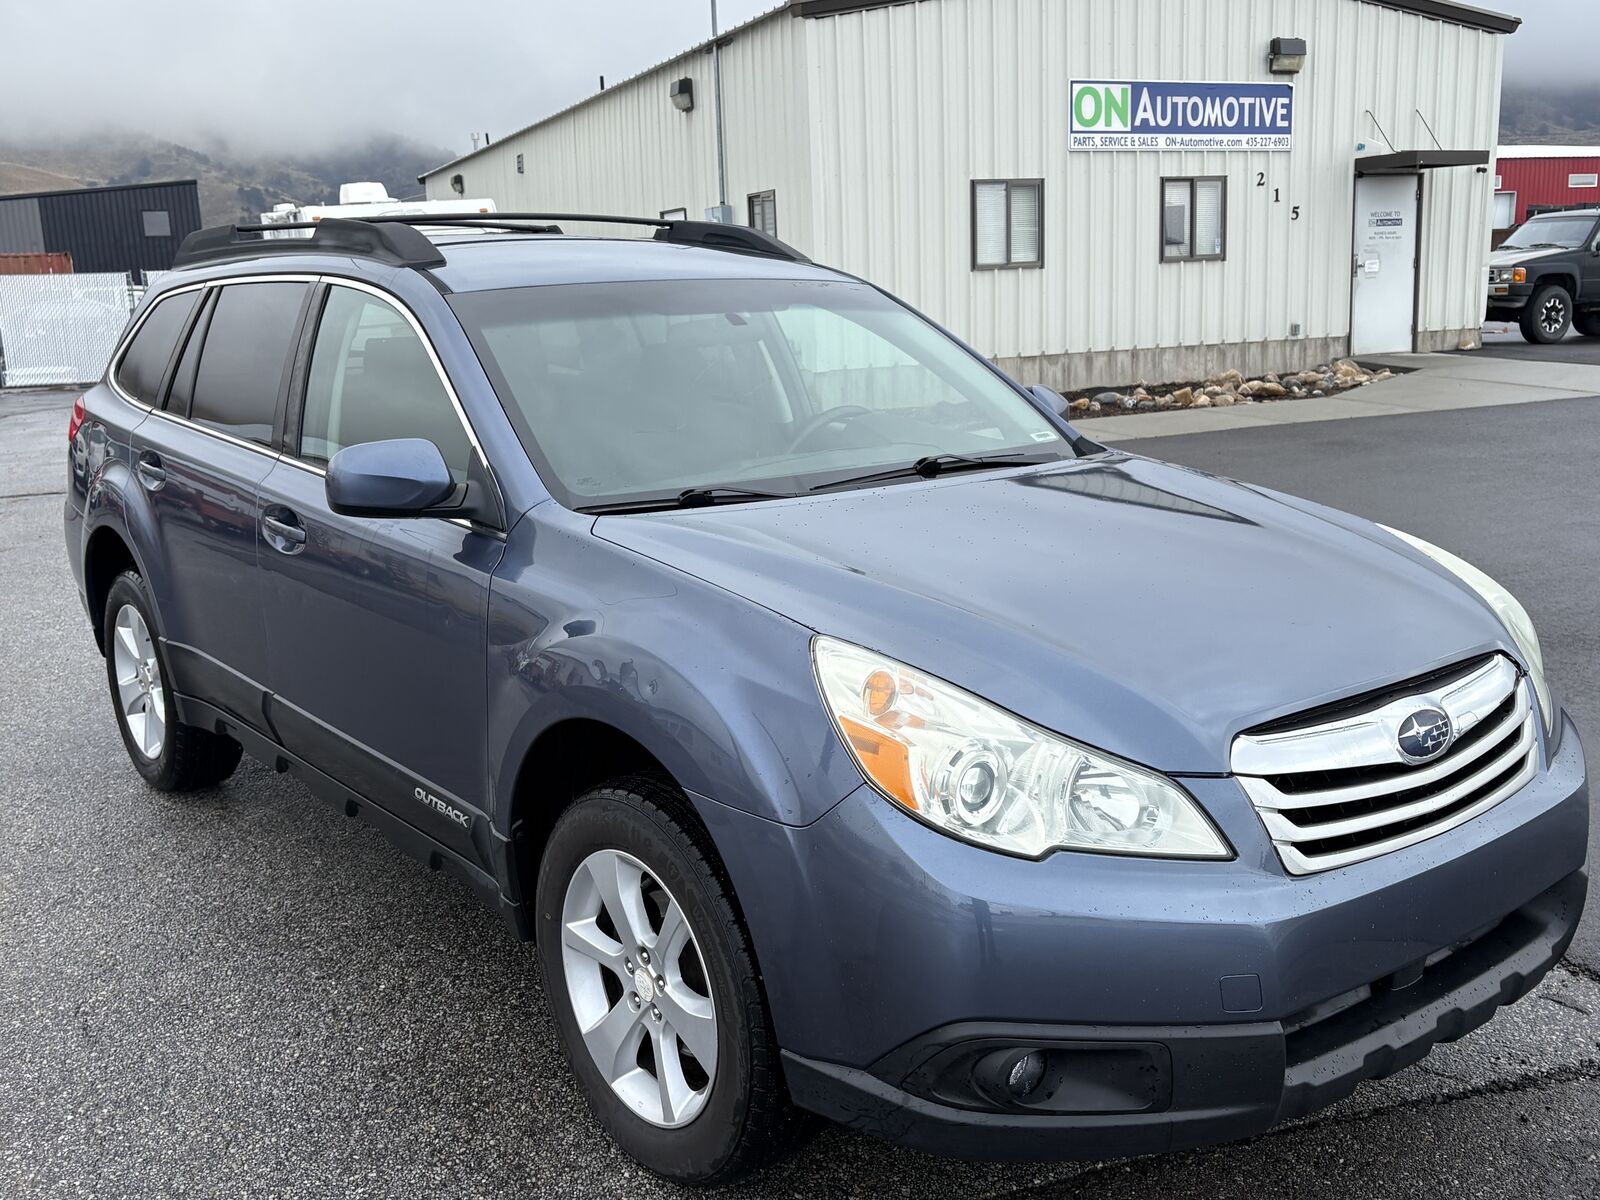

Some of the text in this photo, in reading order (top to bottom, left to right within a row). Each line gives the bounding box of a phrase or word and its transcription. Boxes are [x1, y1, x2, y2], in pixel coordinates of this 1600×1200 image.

[1074, 86, 1290, 128] ON AUTOMOTIVE
[1073, 136, 1289, 149] PARTS, SERVICE & SALES ON-Automotive.com 435-227-6903
[414, 787, 470, 828] OUTBACK
